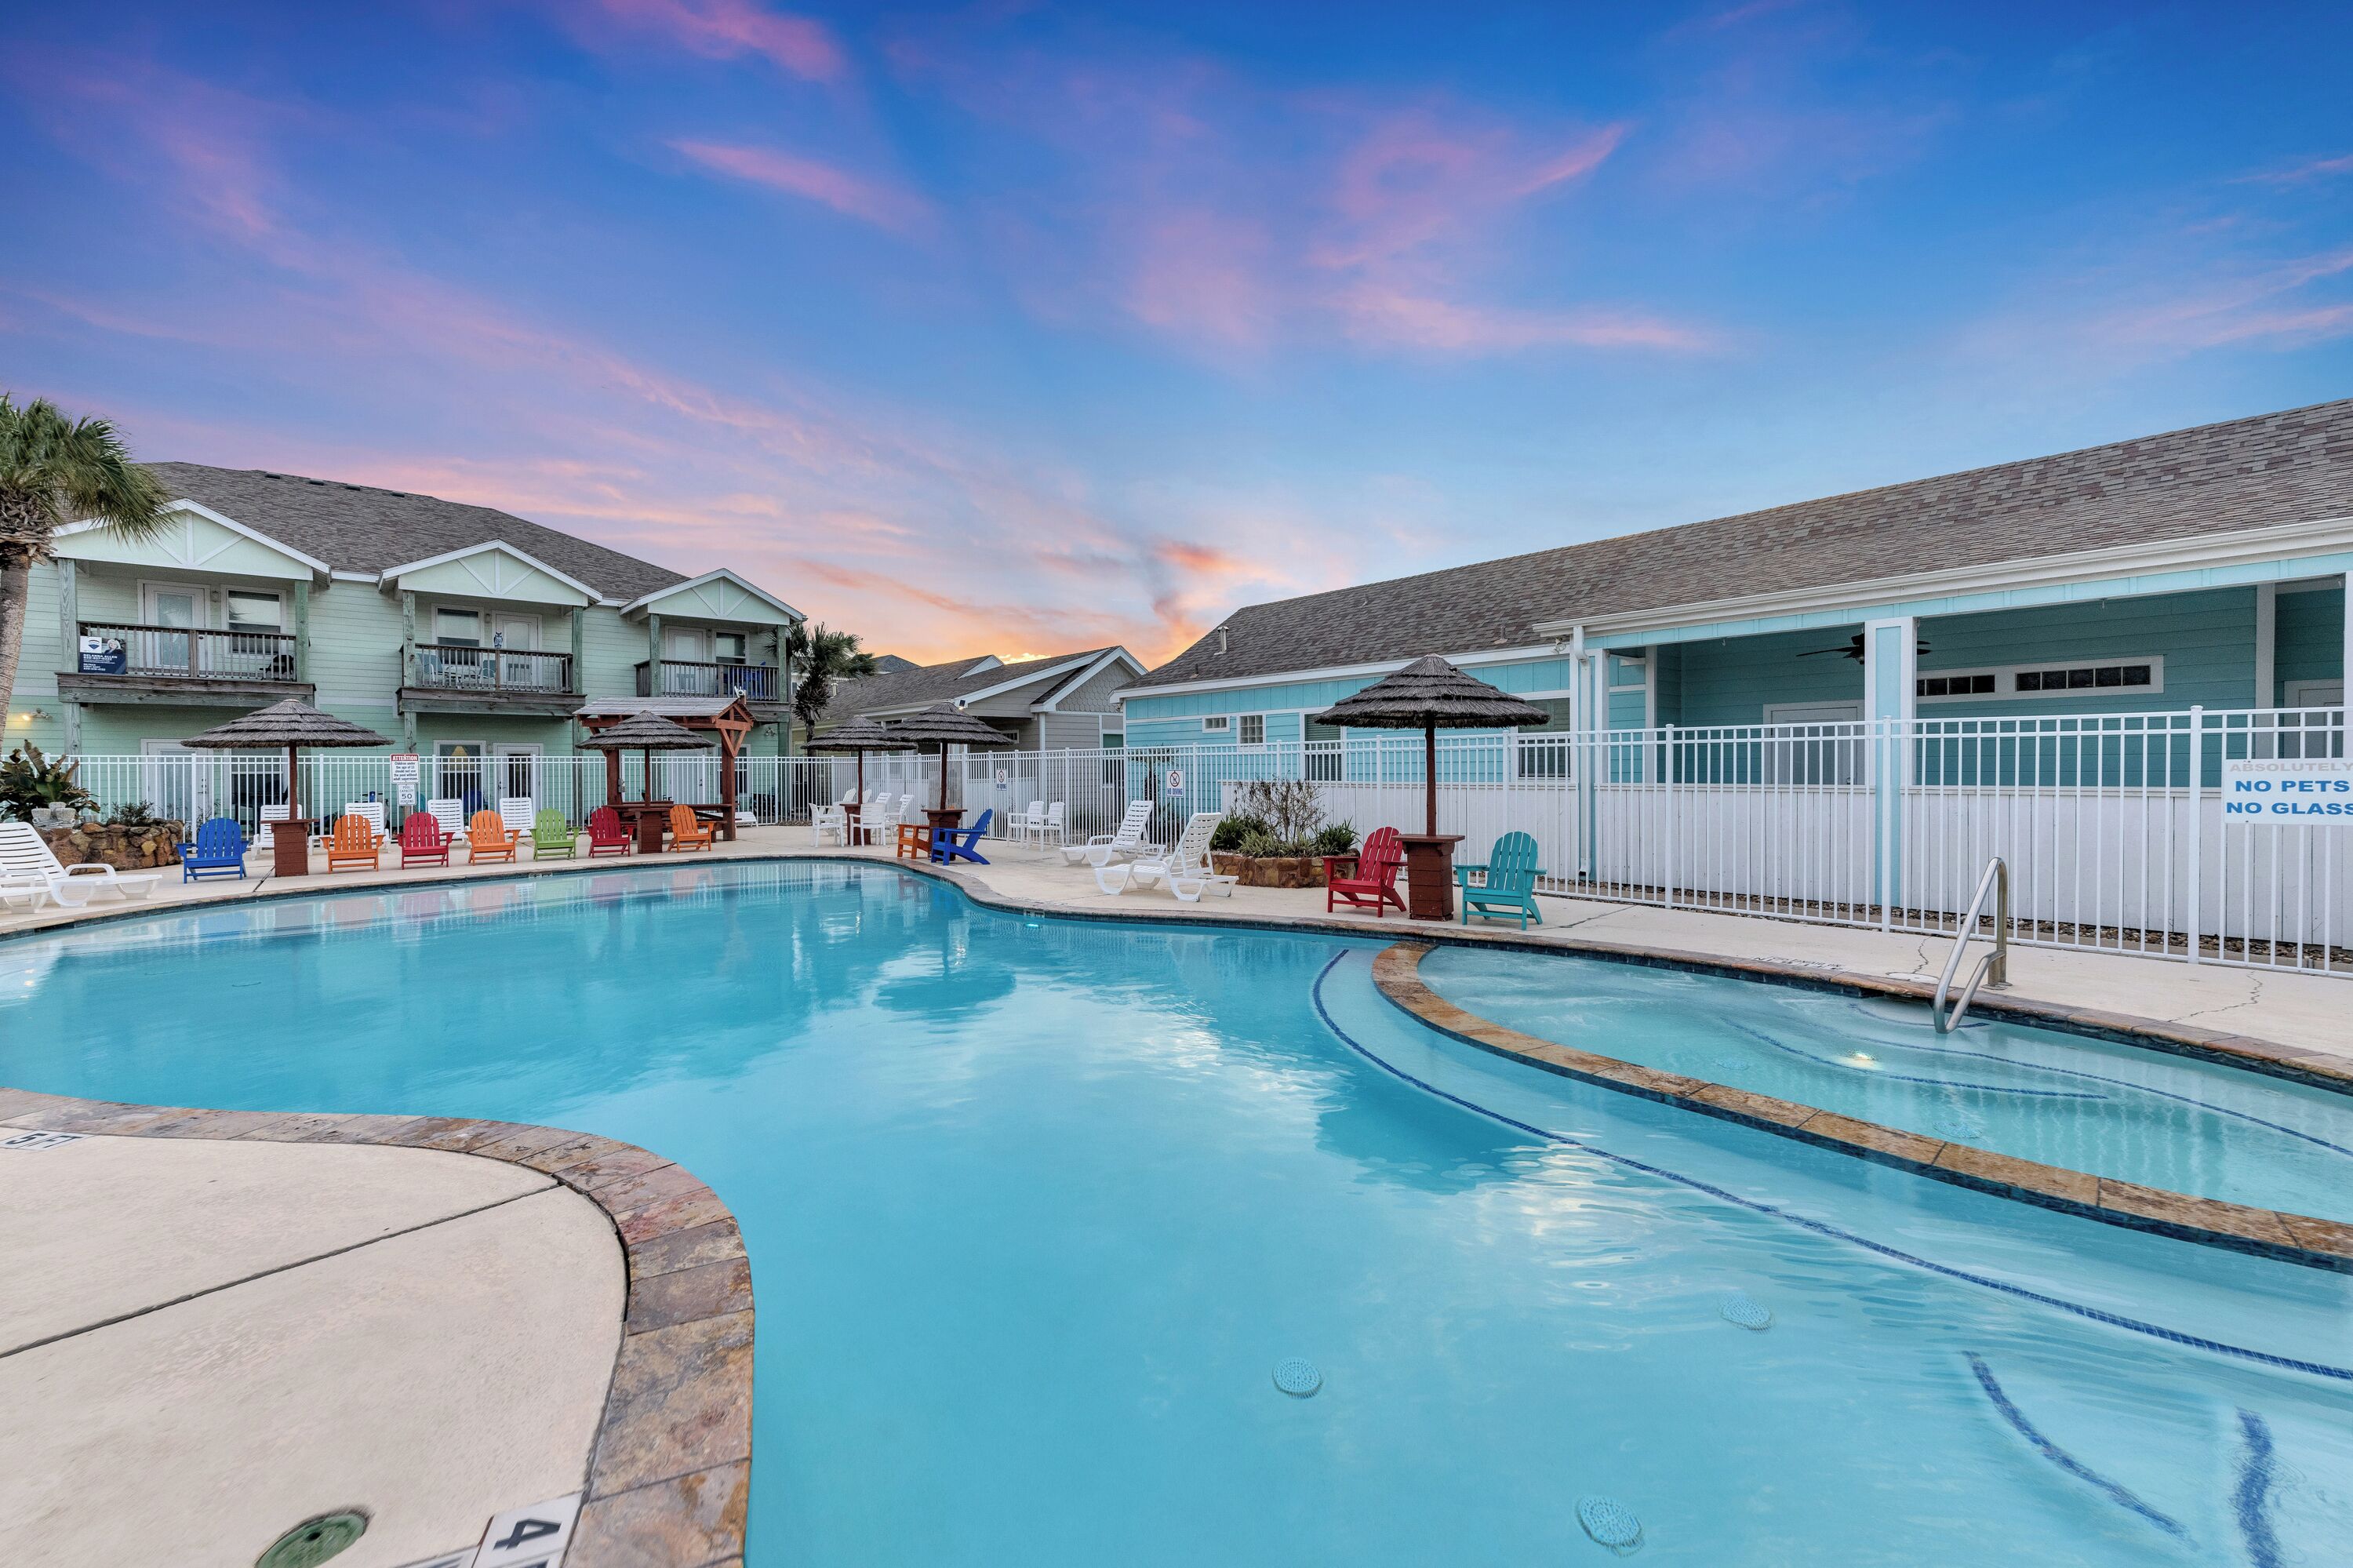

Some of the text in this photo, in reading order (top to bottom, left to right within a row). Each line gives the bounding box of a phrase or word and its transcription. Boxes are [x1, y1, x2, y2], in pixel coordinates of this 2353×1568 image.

[2229, 762, 2353, 773] ABSOLUTELY
[2235, 780, 2350, 792] NO PETS
[2227, 802, 2353, 815] NO GLASS
[5, 1133, 48, 1144] 5
[493, 1519, 562, 1550] 4
